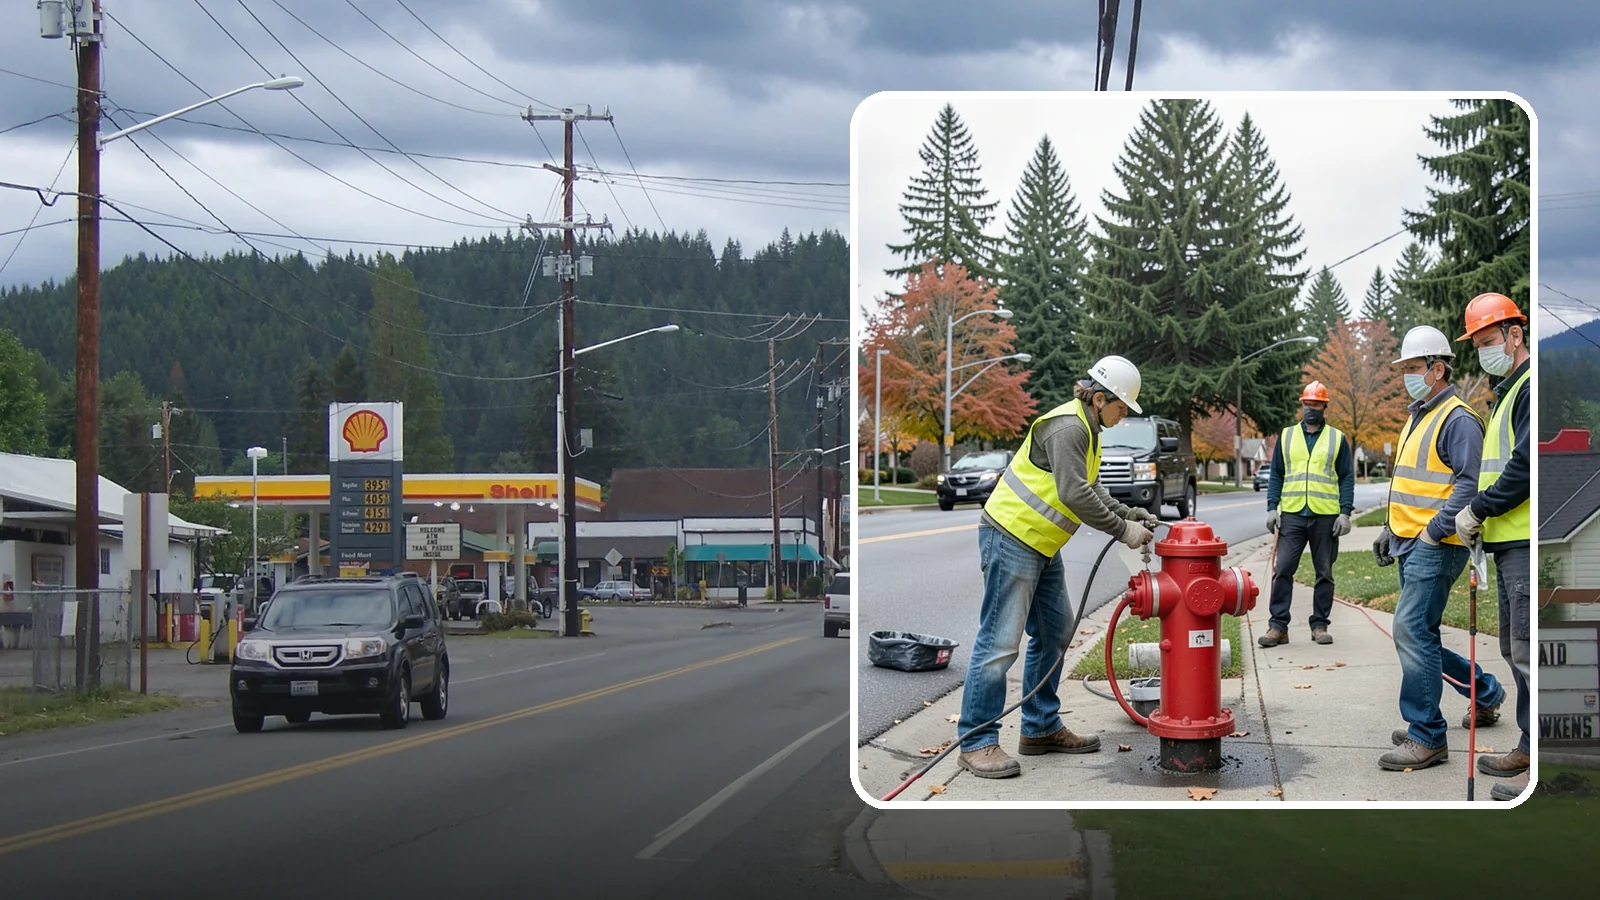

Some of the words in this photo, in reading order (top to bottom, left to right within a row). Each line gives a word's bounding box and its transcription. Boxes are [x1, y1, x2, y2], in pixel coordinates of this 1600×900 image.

[366, 480, 383, 490] 395
[490, 485, 547, 499] Shell
[366, 494, 383, 504] 405
[366, 508, 383, 518] 415
[366, 522, 383, 532] 429
[1539, 643, 1566, 665] AID
[1538, 716, 1592, 739] WKENS
